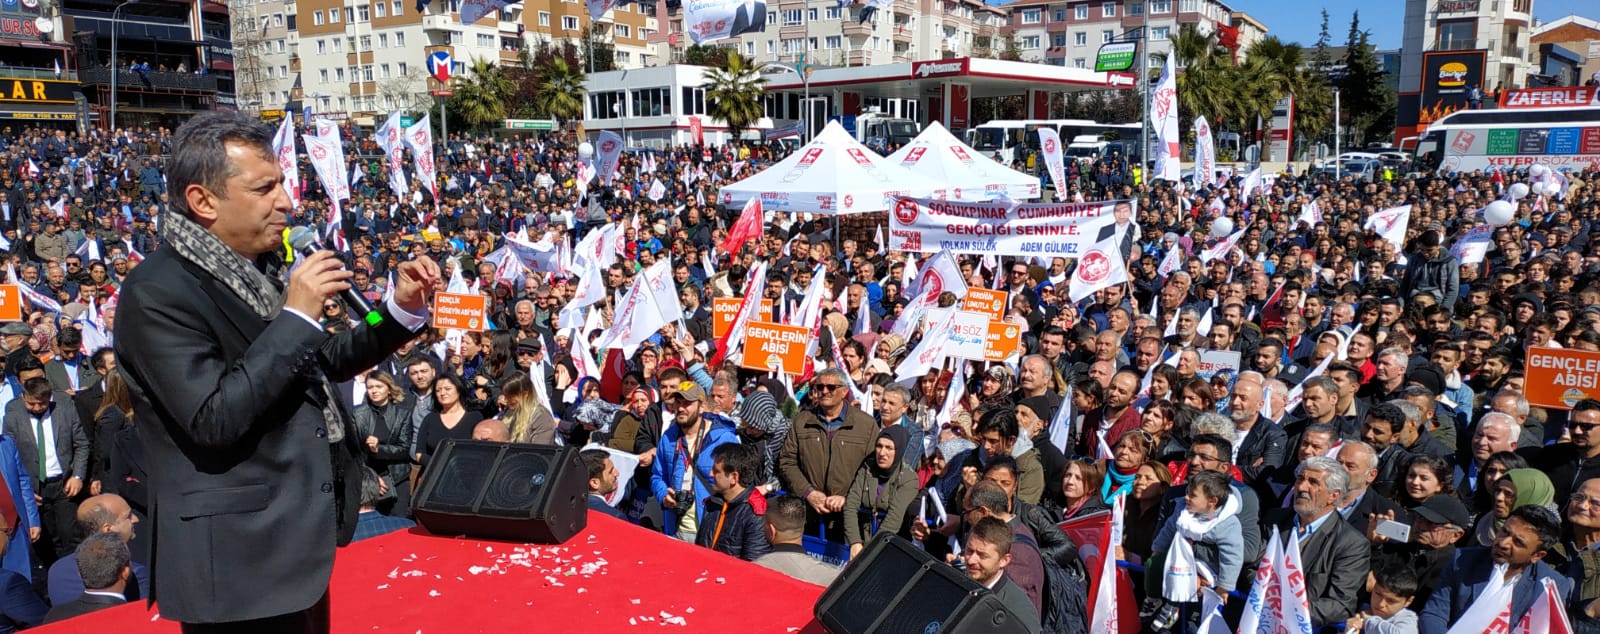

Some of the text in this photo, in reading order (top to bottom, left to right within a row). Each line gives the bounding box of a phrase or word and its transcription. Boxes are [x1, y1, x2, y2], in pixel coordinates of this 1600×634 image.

[915, 62, 962, 77] Aytemiz
[1507, 90, 1587, 106] ZAFERLE
[928, 201, 1103, 220] SOĞUKPINAR CUMHURİYET
[940, 240, 970, 250] VOLKAN
[1021, 240, 1078, 253] ADEM GÜLMEZ
[748, 327, 807, 344] GENÇLERİN
[962, 325, 982, 337] SÖZ
[761, 341, 789, 354] ABİSİ
[1553, 371, 1598, 389] ABİSİ
